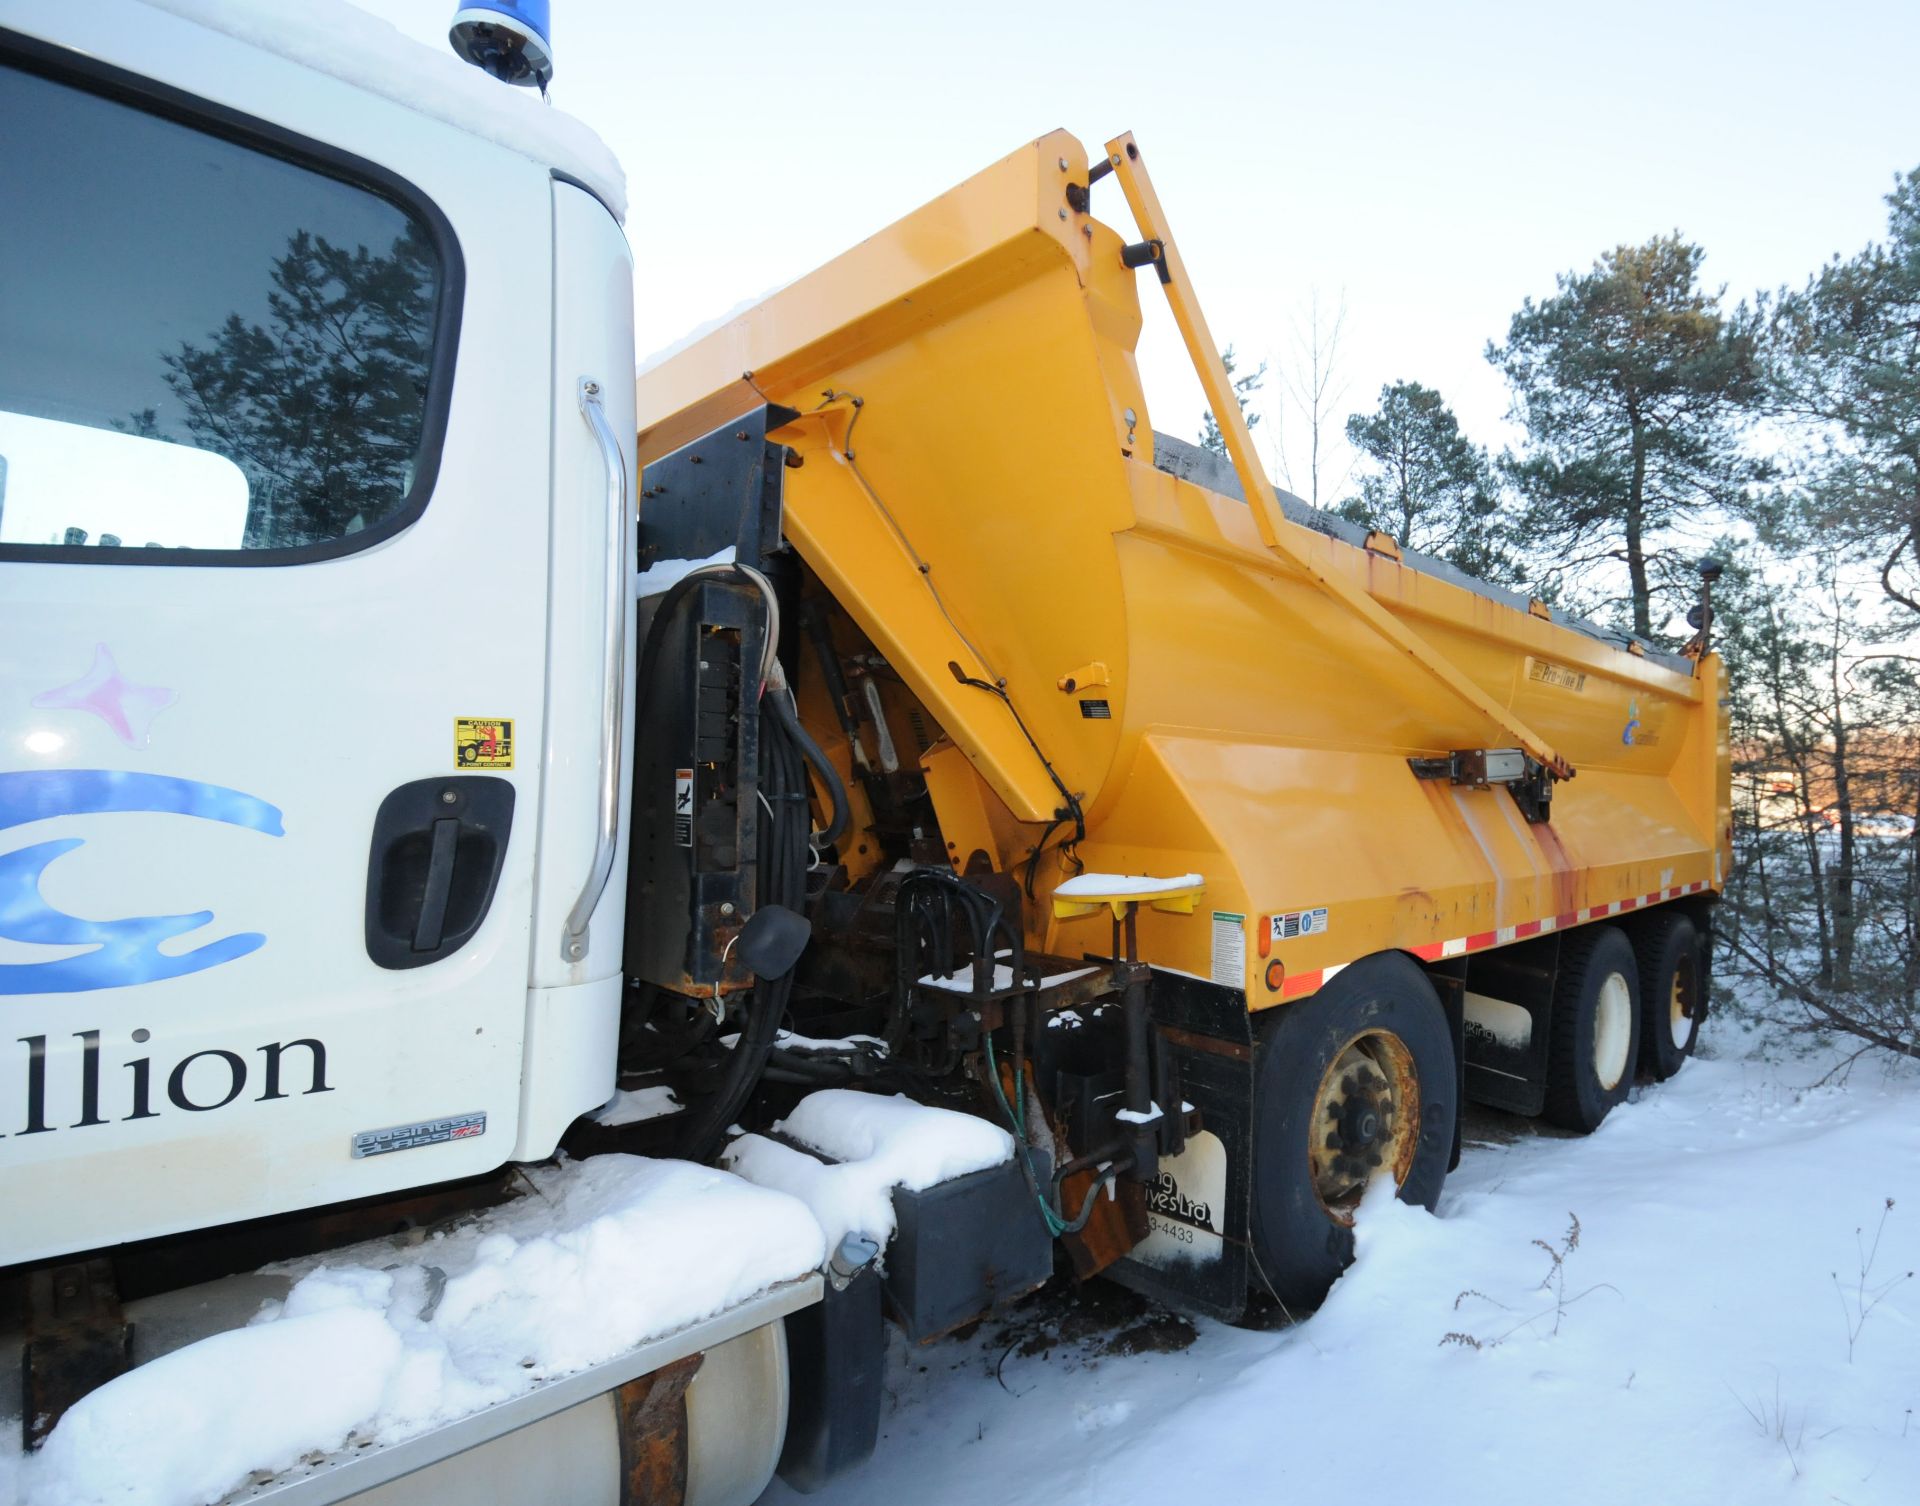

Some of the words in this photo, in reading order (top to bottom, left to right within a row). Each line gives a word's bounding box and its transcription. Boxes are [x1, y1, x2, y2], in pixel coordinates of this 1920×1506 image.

[1464, 1020, 1494, 1043] iking
[0, 1028, 336, 1137] llion
[356, 1113, 485, 1145] BUSINESS
[356, 1132, 450, 1158] CLASS
[452, 1124, 481, 1140] M2
[1145, 1184, 1177, 1211] ives
[1150, 1217, 1193, 1244] 3-4433
